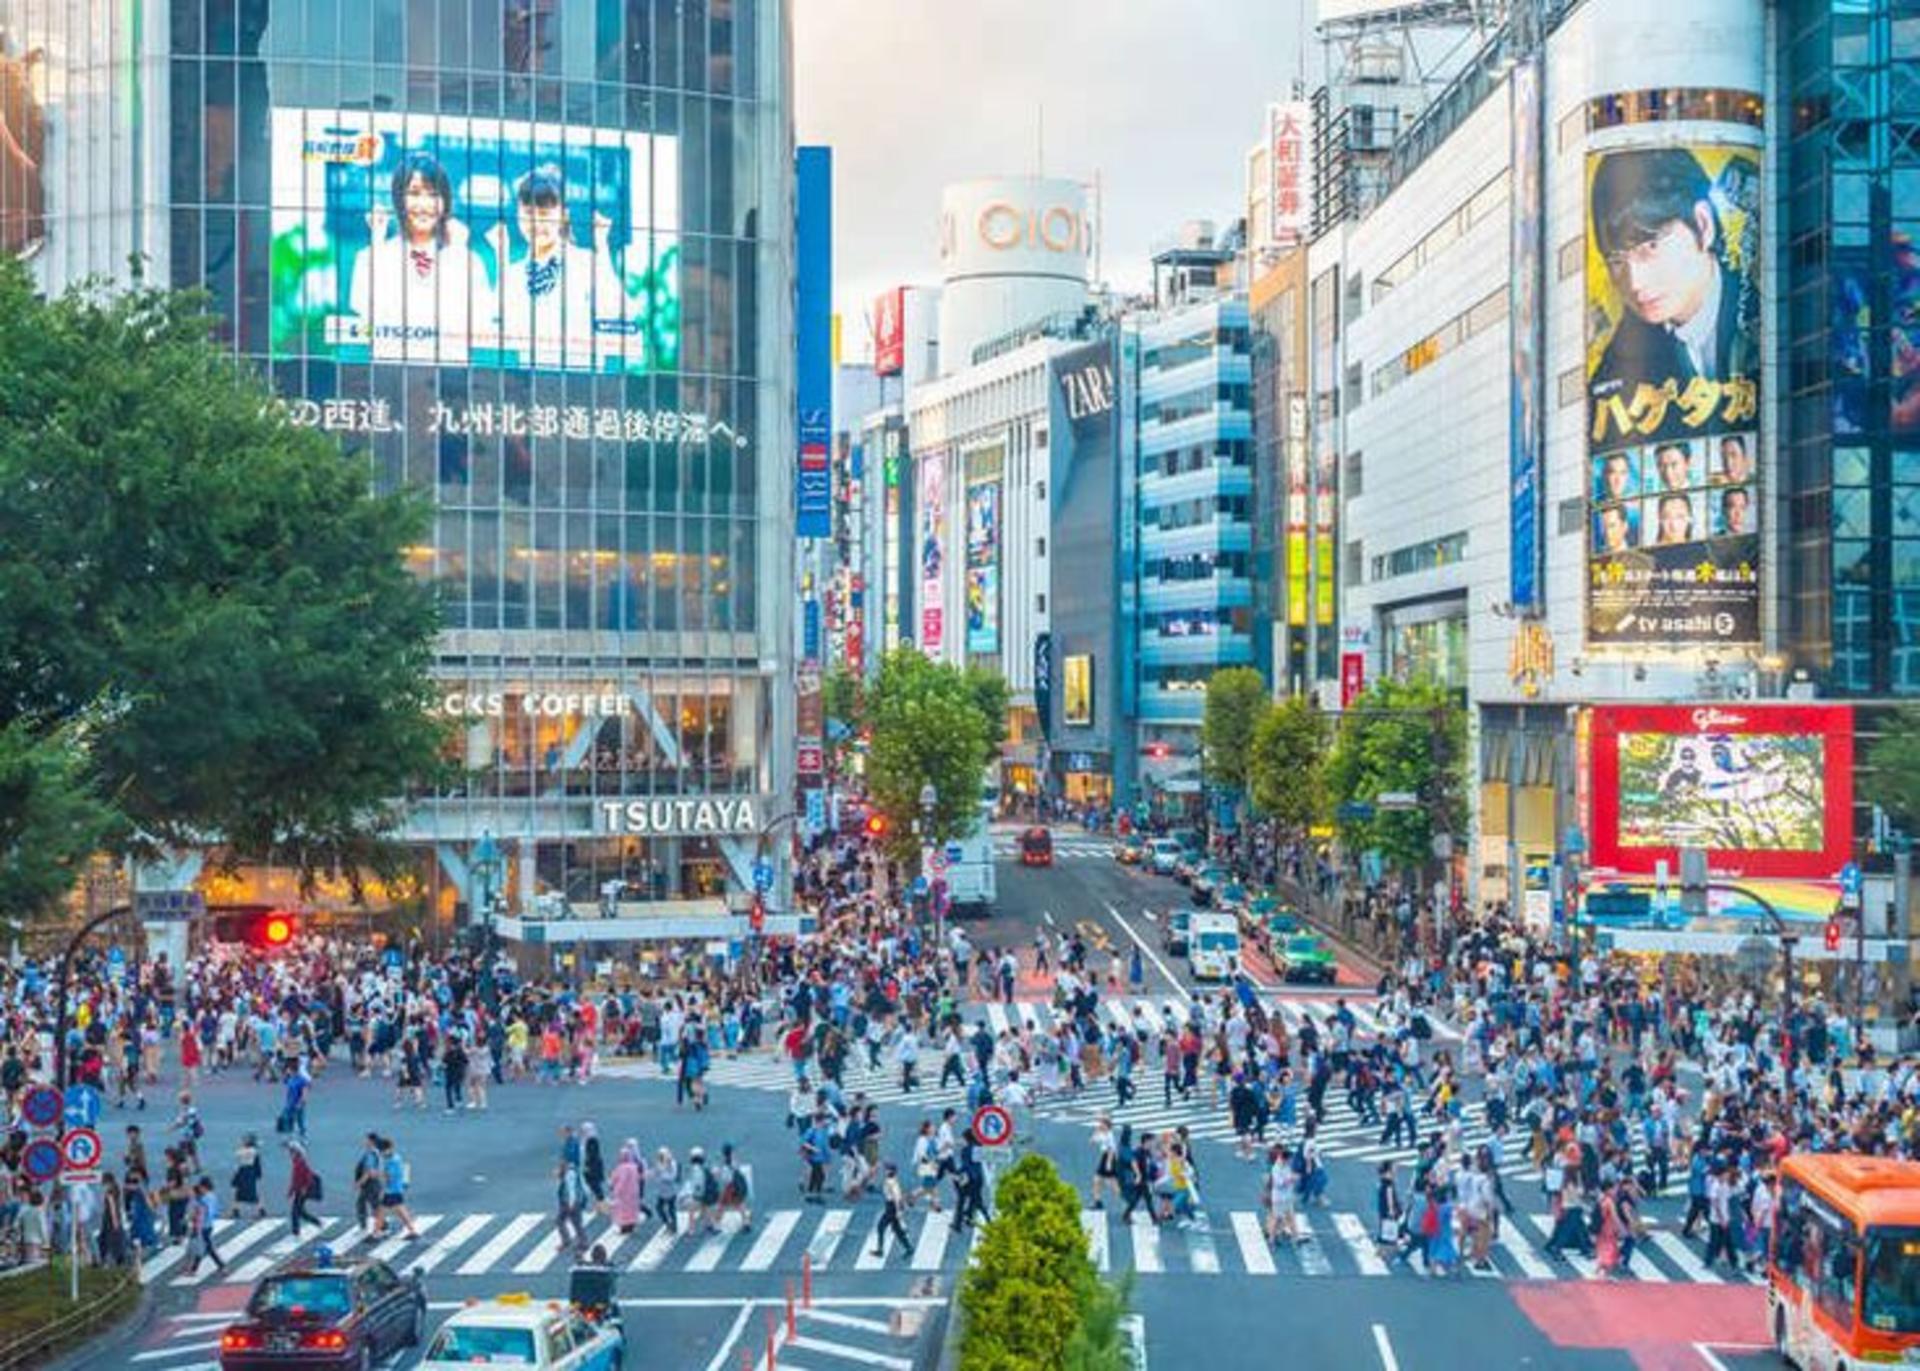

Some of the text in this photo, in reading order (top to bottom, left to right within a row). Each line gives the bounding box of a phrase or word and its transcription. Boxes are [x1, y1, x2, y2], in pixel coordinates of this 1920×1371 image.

[268, 400, 404, 433] の西進、
[1593, 375, 1756, 442] ハゲタカ
[1638, 616, 1658, 633] tv
[1662, 614, 1712, 632] asahi
[421, 692, 631, 717] CKS COFFEE
[603, 800, 755, 831] TSUTAYA
